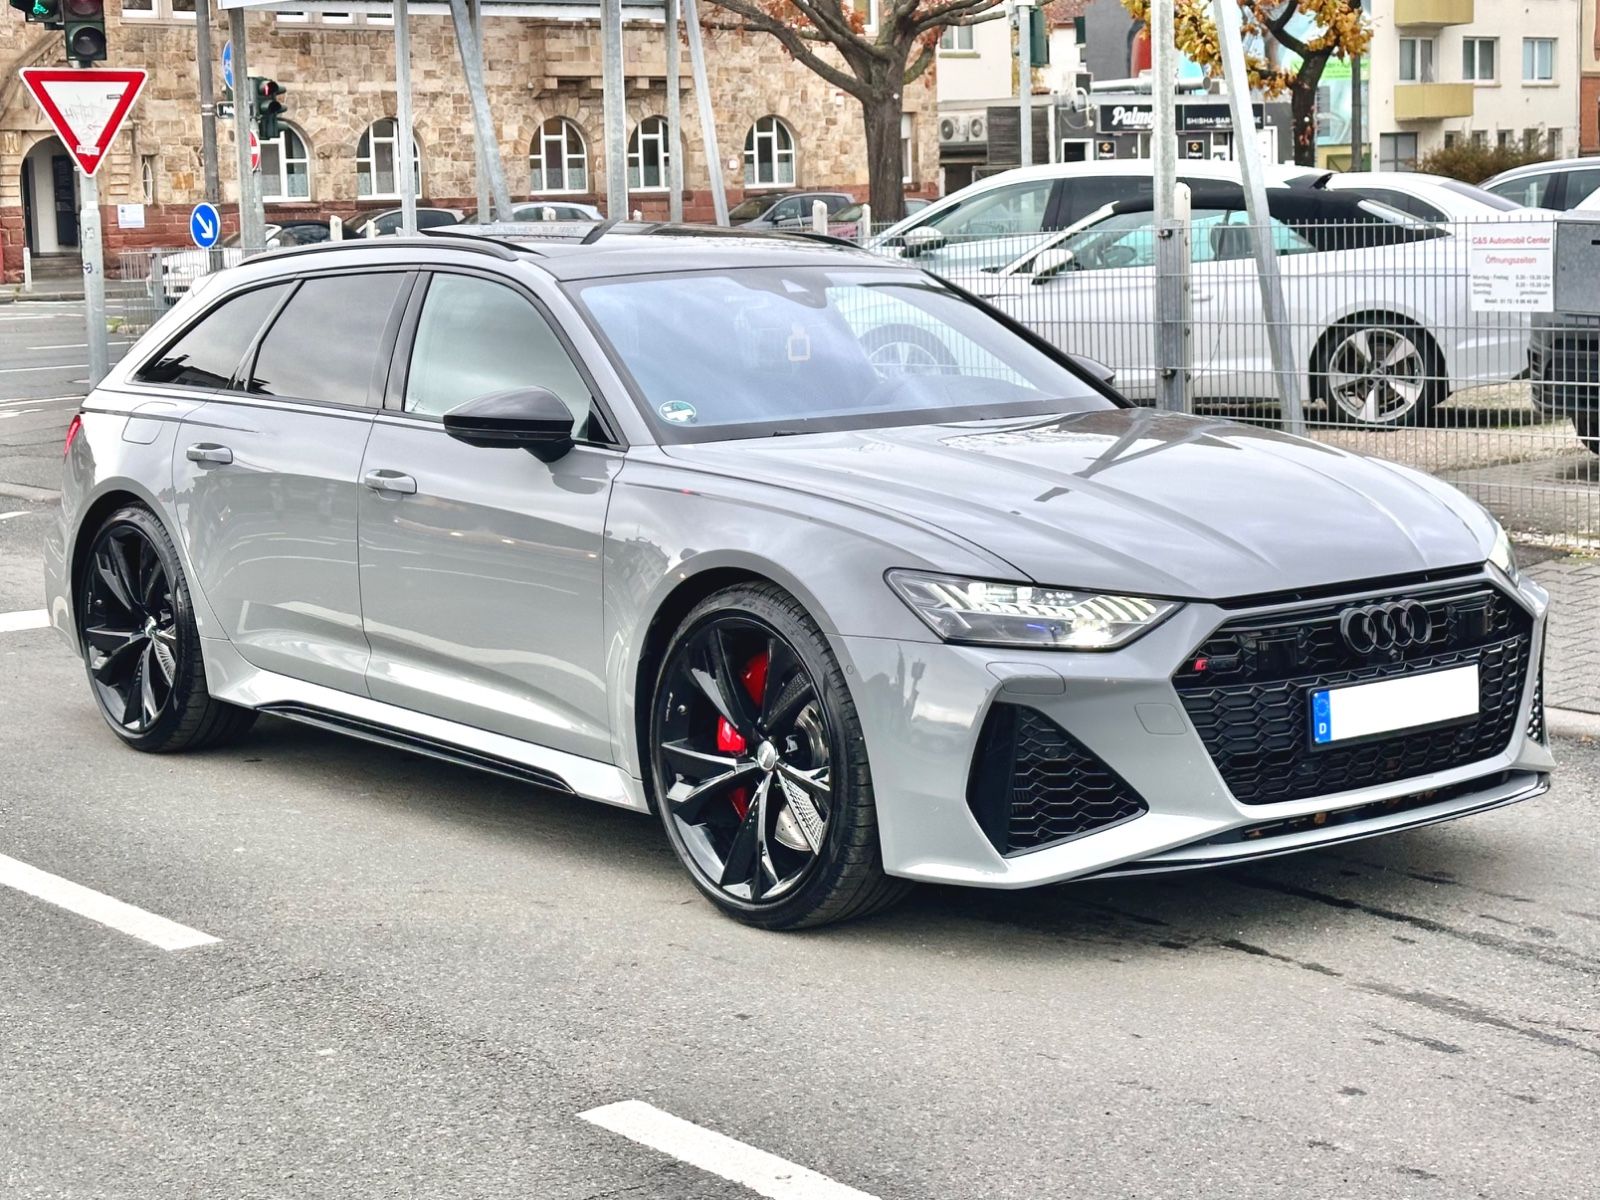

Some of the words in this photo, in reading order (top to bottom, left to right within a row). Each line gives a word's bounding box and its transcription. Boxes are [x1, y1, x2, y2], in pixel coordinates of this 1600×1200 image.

[1527, 236, 1550, 244] Center
[1485, 254, 1537, 266] Öffnungszeiten
[1319, 722, 1327, 735] D
